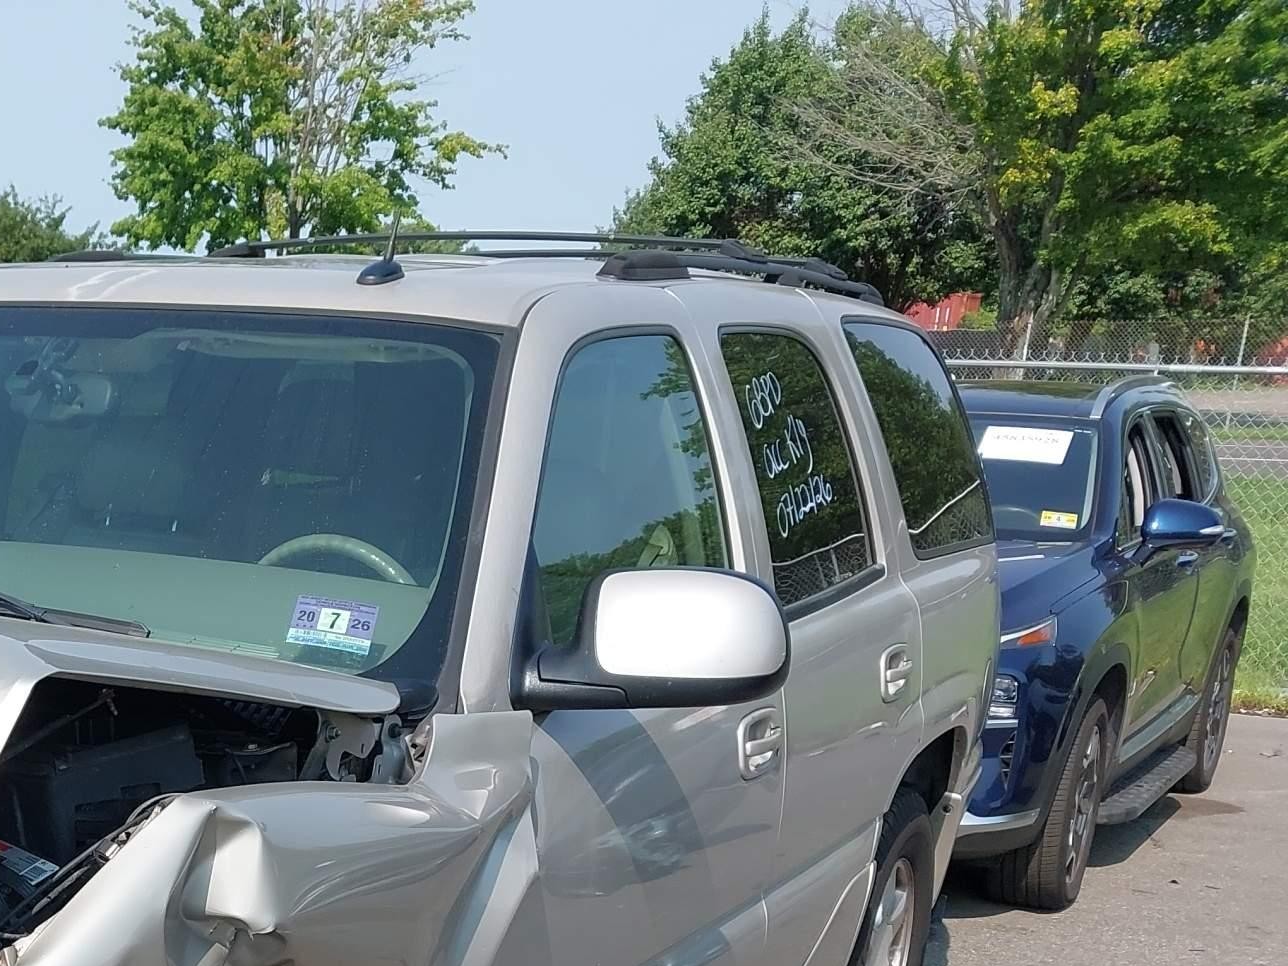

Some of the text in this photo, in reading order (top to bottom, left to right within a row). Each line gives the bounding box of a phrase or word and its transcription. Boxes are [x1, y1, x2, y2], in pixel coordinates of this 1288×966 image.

[297, 610, 371, 632] 20 7 26
